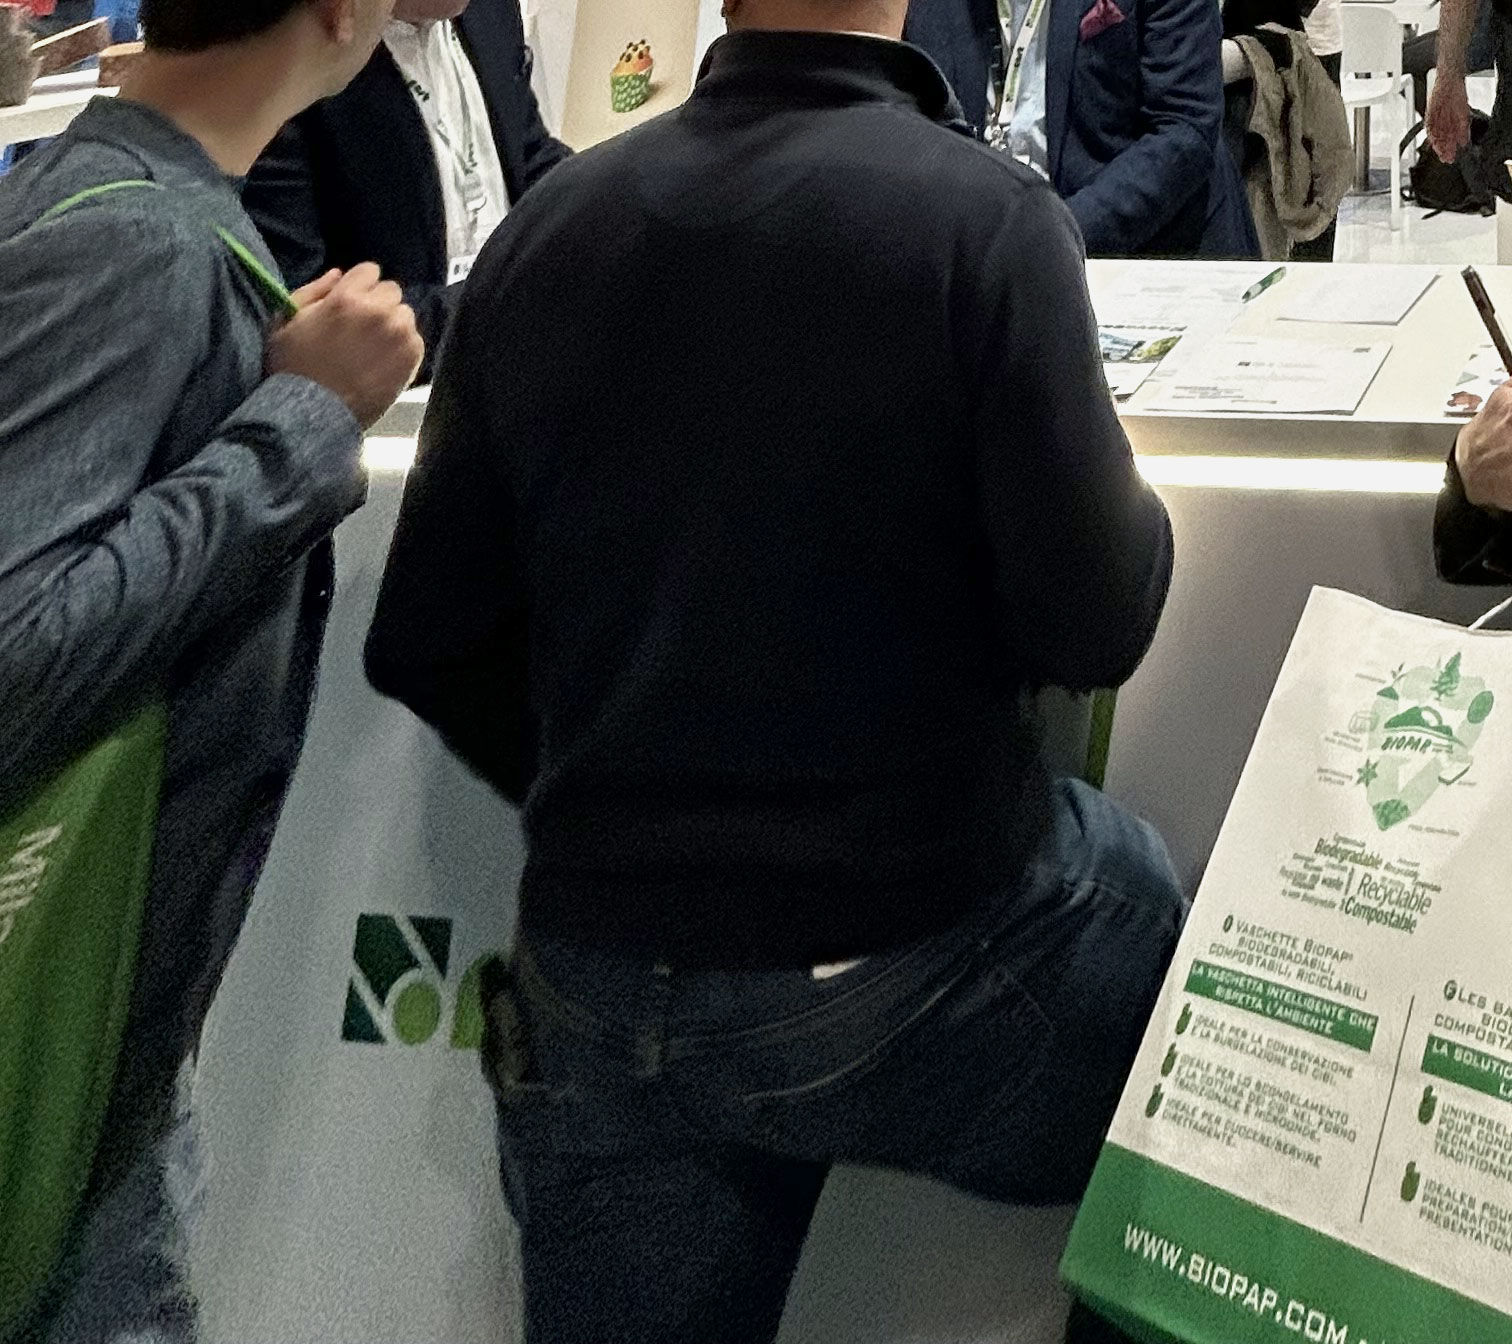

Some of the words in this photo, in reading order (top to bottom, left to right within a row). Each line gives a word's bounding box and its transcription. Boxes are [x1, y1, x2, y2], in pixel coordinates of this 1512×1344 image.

[1381, 735, 1432, 754] BIOPAP
[1314, 837, 1383, 870] Biodegradable
[1357, 872, 1432, 915] Recyclable
[1236, 919, 1300, 949] VASCHETTE
[1344, 896, 1418, 935] Compostable
[1208, 942, 1292, 979] COMPOSTABILI,
[1296, 968, 1368, 1002] RICICLABILI
[1238, 936, 1336, 976] BIODEGRADABILI,
[1192, 963, 1204, 976] LA
[1207, 966, 1264, 994] VASCHETTA
[1266, 983, 1346, 1022] INTELLIGENTE
[1349, 1010, 1376, 1032] CHE
[1215, 984, 1264, 1011] RISPETTA
[1266, 998, 1334, 1035] L'AMBIENTE
[1457, 986, 1488, 1010] LES
[1250, 1032, 1264, 1045] LA
[1265, 1036, 1355, 1079] CONSERVAZIONE
[1431, 1039, 1450, 1058] LA
[1438, 1116, 1472, 1136] POUR
[1123, 1222, 1349, 1344] WWW.BIOPAP.COM
